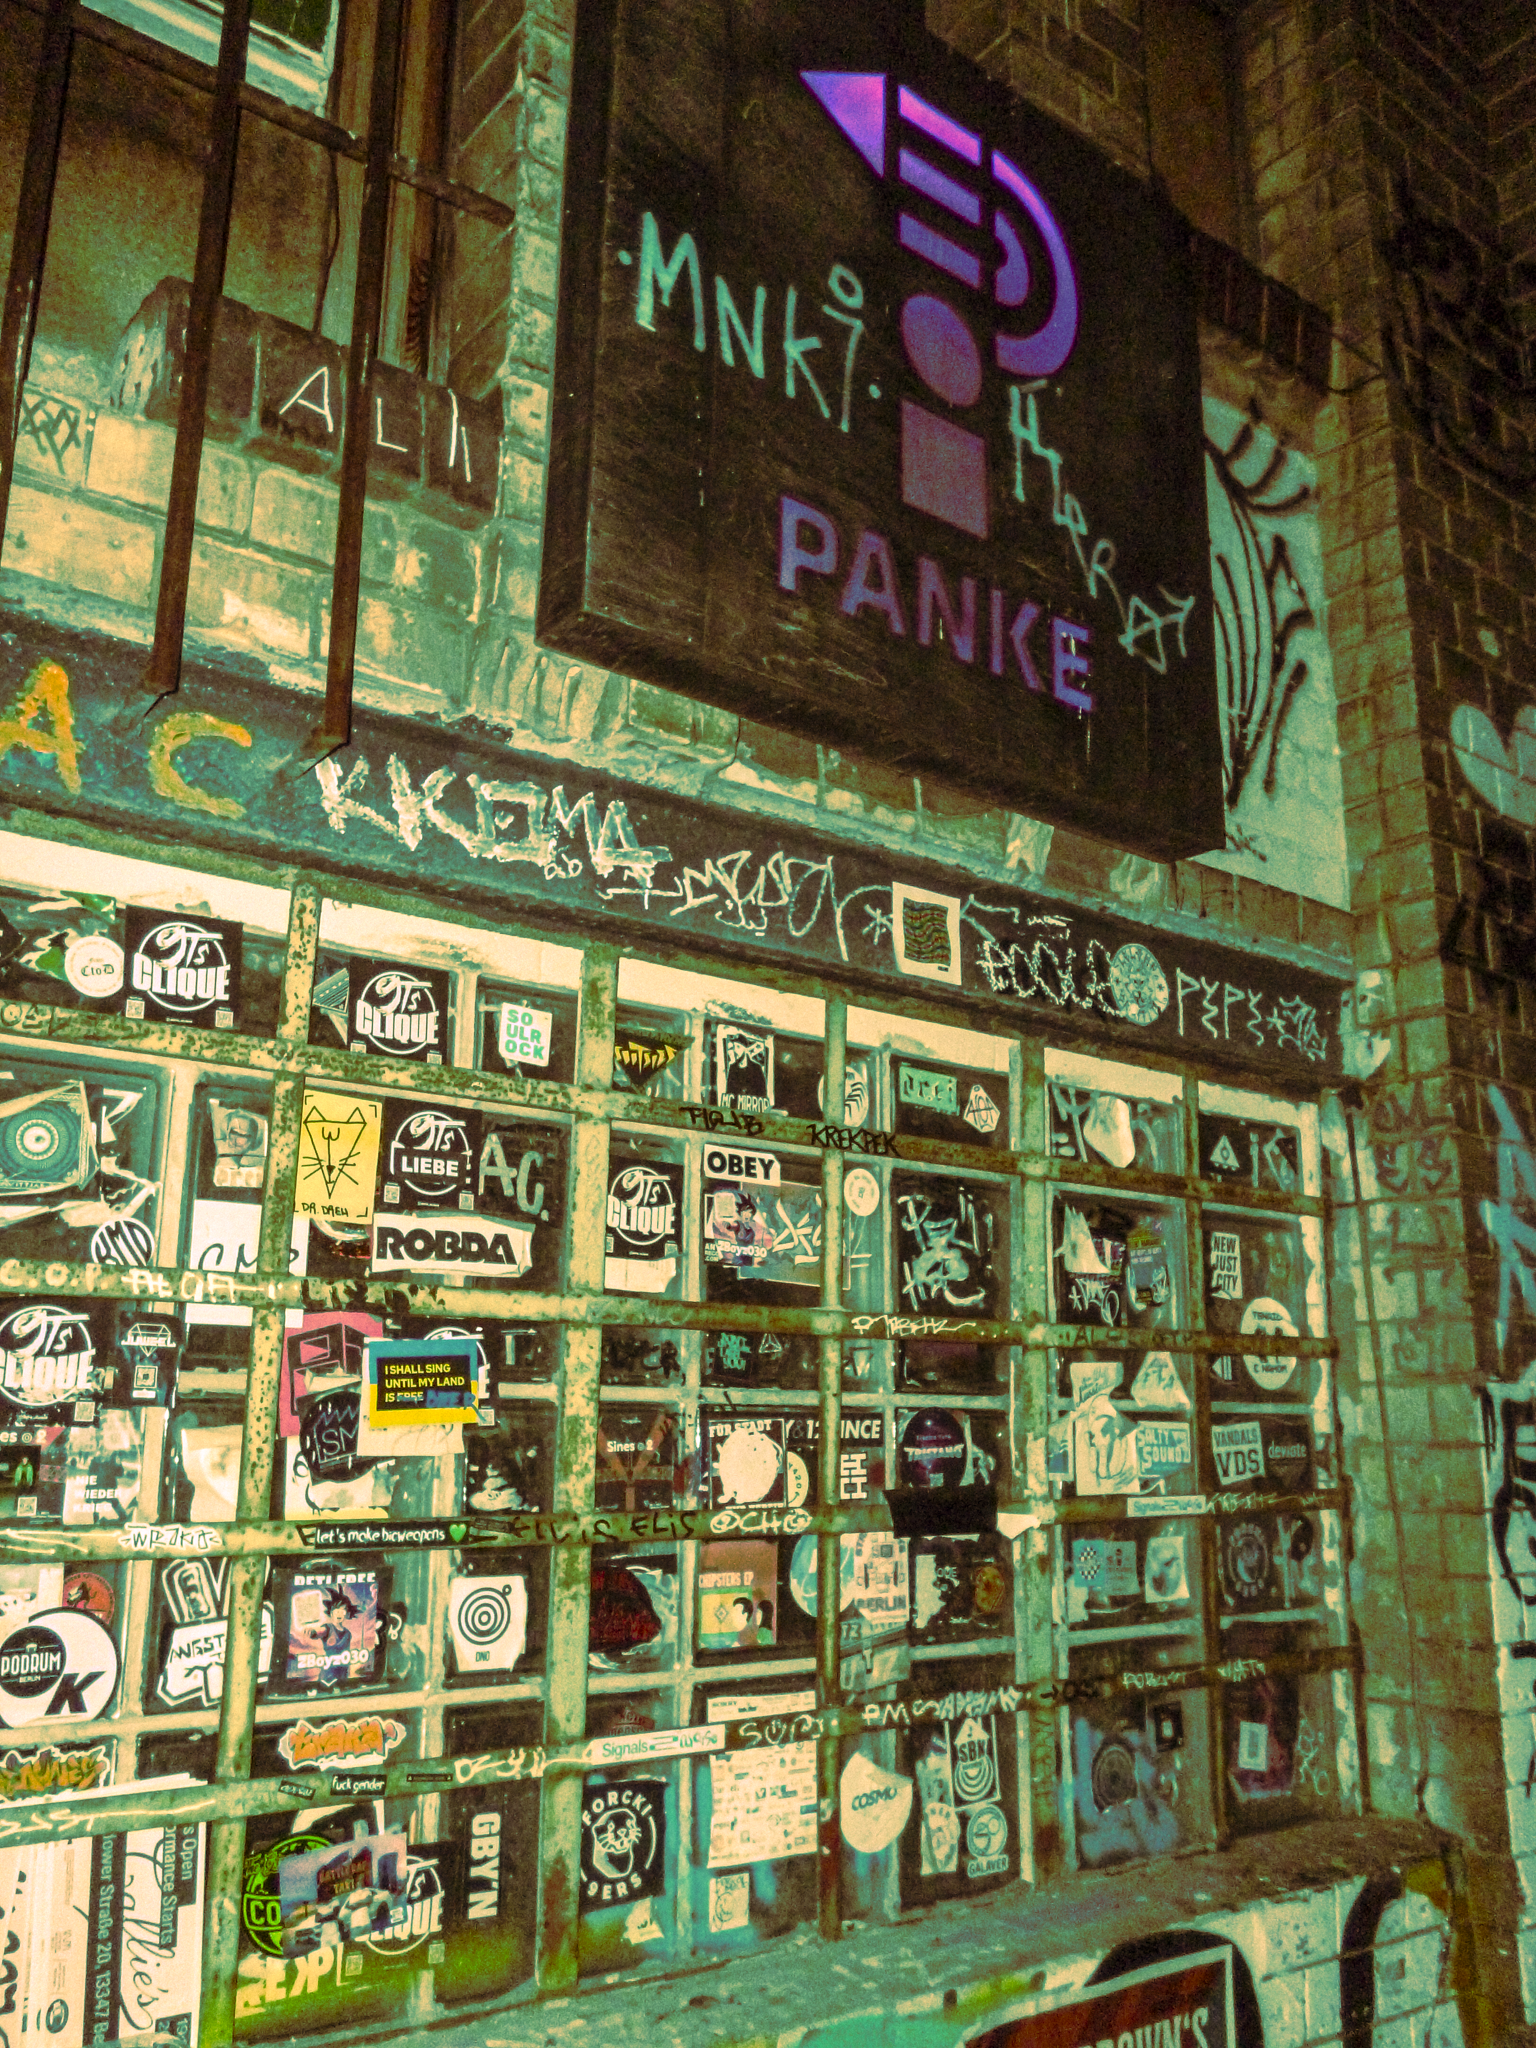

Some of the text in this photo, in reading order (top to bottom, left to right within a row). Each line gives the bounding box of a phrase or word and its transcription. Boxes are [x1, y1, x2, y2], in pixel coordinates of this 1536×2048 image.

[776, 494, 1095, 713] PANKE
[132, 951, 231, 1000] CLIQUE
[356, 999, 440, 1044] CLIQUE
[507, 1009, 533, 1025] SO
[506, 1024, 543, 1044] ULR
[504, 1038, 545, 1060] OCK
[721, 1093, 734, 1107] MC
[737, 1093, 771, 1114] MIRROR
[401, 1155, 459, 1177] LIEBE
[707, 1151, 775, 1180] OBEY
[606, 1194, 676, 1235] CLIQUE
[376, 1226, 518, 1266] ROBDA
[1213, 1236, 1236, 1253] NEW
[1212, 1255, 1238, 1274] JUST
[1215, 1273, 1238, 1292] CITY
[0, 1348, 96, 1391] LIQUE
[384, 1363, 451, 1375] I SHALL SING
[385, 1376, 465, 1388] UNTIL MY LAND
[385, 1392, 395, 1402] IS
[606, 1440, 635, 1452] Sines
[1213, 1428, 1258, 1447] VANDALS
[1217, 1449, 1260, 1477] VDS
[316, 1526, 446, 1545] let's make bioweapons
[1, 1652, 62, 1677] PODRUM
[19, 1674, 41, 1683] BERLIN
[44, 1671, 107, 1716] K
[602, 1739, 649, 1760] Signals
[332, 1776, 385, 1794] fuck gender
[851, 1785, 898, 1811] COSMO
[181, 1838, 198, 1881] Open
[98, 1884, 116, 1940] Straße
[160, 1895, 178, 1945] Starts
[96, 1942, 113, 1970] 20,
[94, 1970, 112, 2020] 13347
